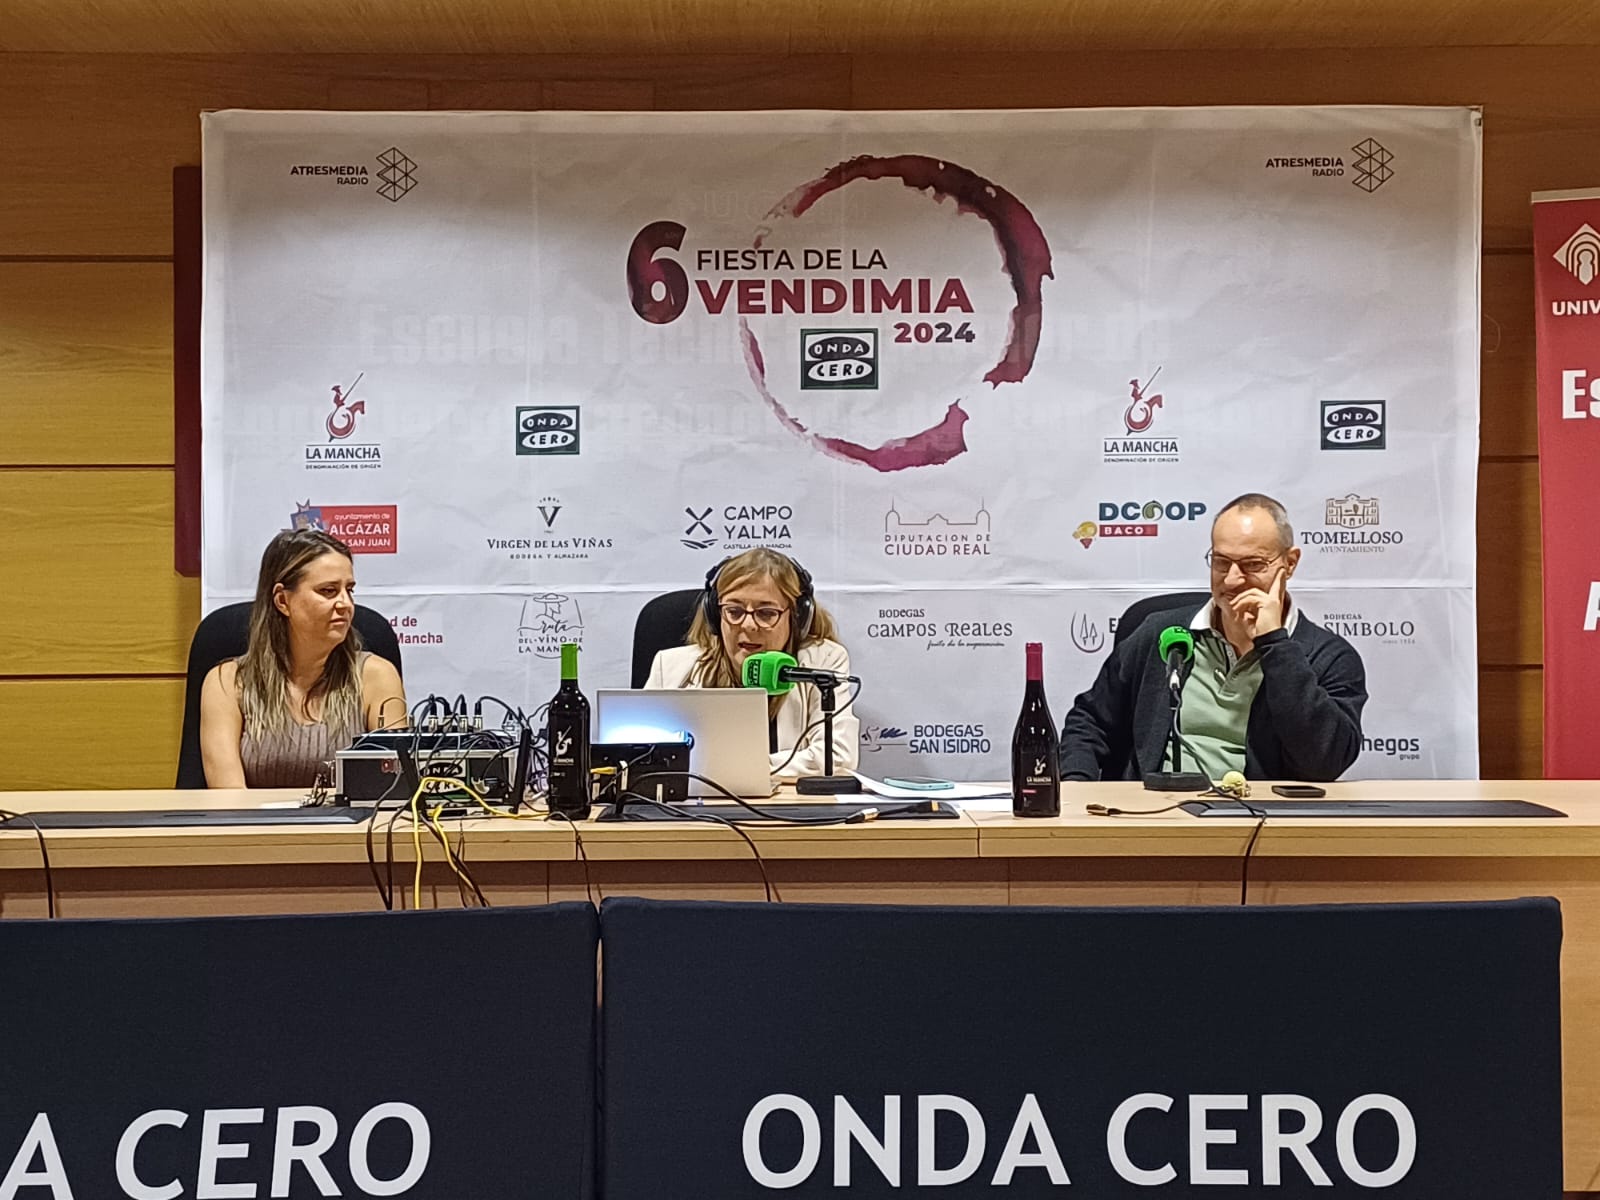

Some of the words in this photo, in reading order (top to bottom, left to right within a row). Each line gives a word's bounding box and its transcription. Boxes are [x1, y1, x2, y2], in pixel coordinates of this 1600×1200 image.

[1265, 157, 1344, 168] ATRESMEDIA
[290, 166, 368, 175] ATRESMEDIA
[1312, 168, 1344, 176] RADIO
[337, 177, 369, 185] RADIO
[697, 249, 794, 271] FIESTA
[803, 249, 843, 269] DE
[852, 249, 888, 269] LA
[626, 220, 690, 325] 6
[695, 278, 974, 315] VENDIMIA
[894, 322, 975, 343] 2024
[813, 343, 864, 355] ONDA
[816, 363, 865, 377] CERO
[526, 418, 568, 428] ONDA
[1331, 412, 1374, 422] ONDA
[529, 434, 569, 446] CERO
[1333, 428, 1374, 440] CERO
[305, 447, 322, 460] LA
[324, 446, 381, 460] MANCHA
[1104, 441, 1120, 453] LA
[1122, 440, 1179, 453] MANCHA
[724, 505, 793, 521] CAMPO
[1099, 501, 1207, 521] DCOOP
[329, 520, 391, 536] ALCÁZAR
[724, 525, 792, 540] YALMA
[1104, 526, 1145, 536] BACO
[347, 538, 366, 547] SAN
[367, 538, 391, 547] JUAN
[487, 539, 531, 550] VIRGEN
[534, 540, 549, 549] DE
[551, 539, 569, 549] LAS
[572, 537, 614, 549] VIÑAS
[976, 534, 991, 542] DE
[1300, 531, 1404, 545] TOMELLOSO
[884, 544, 948, 556] CIUDAD
[953, 543, 991, 556] REAL
[401, 616, 418, 627] de
[397, 632, 444, 645] Mancha
[518, 646, 532, 654] LA
[536, 645, 583, 654] MANA
[914, 724, 983, 737] BODEGAS
[909, 739, 939, 753] SAN
[943, 739, 991, 753] ISIDRO
[741, 1093, 1071, 1189] ONDA
[1106, 1092, 1417, 1188] CERO
[115, 1101, 431, 1200] CERO
